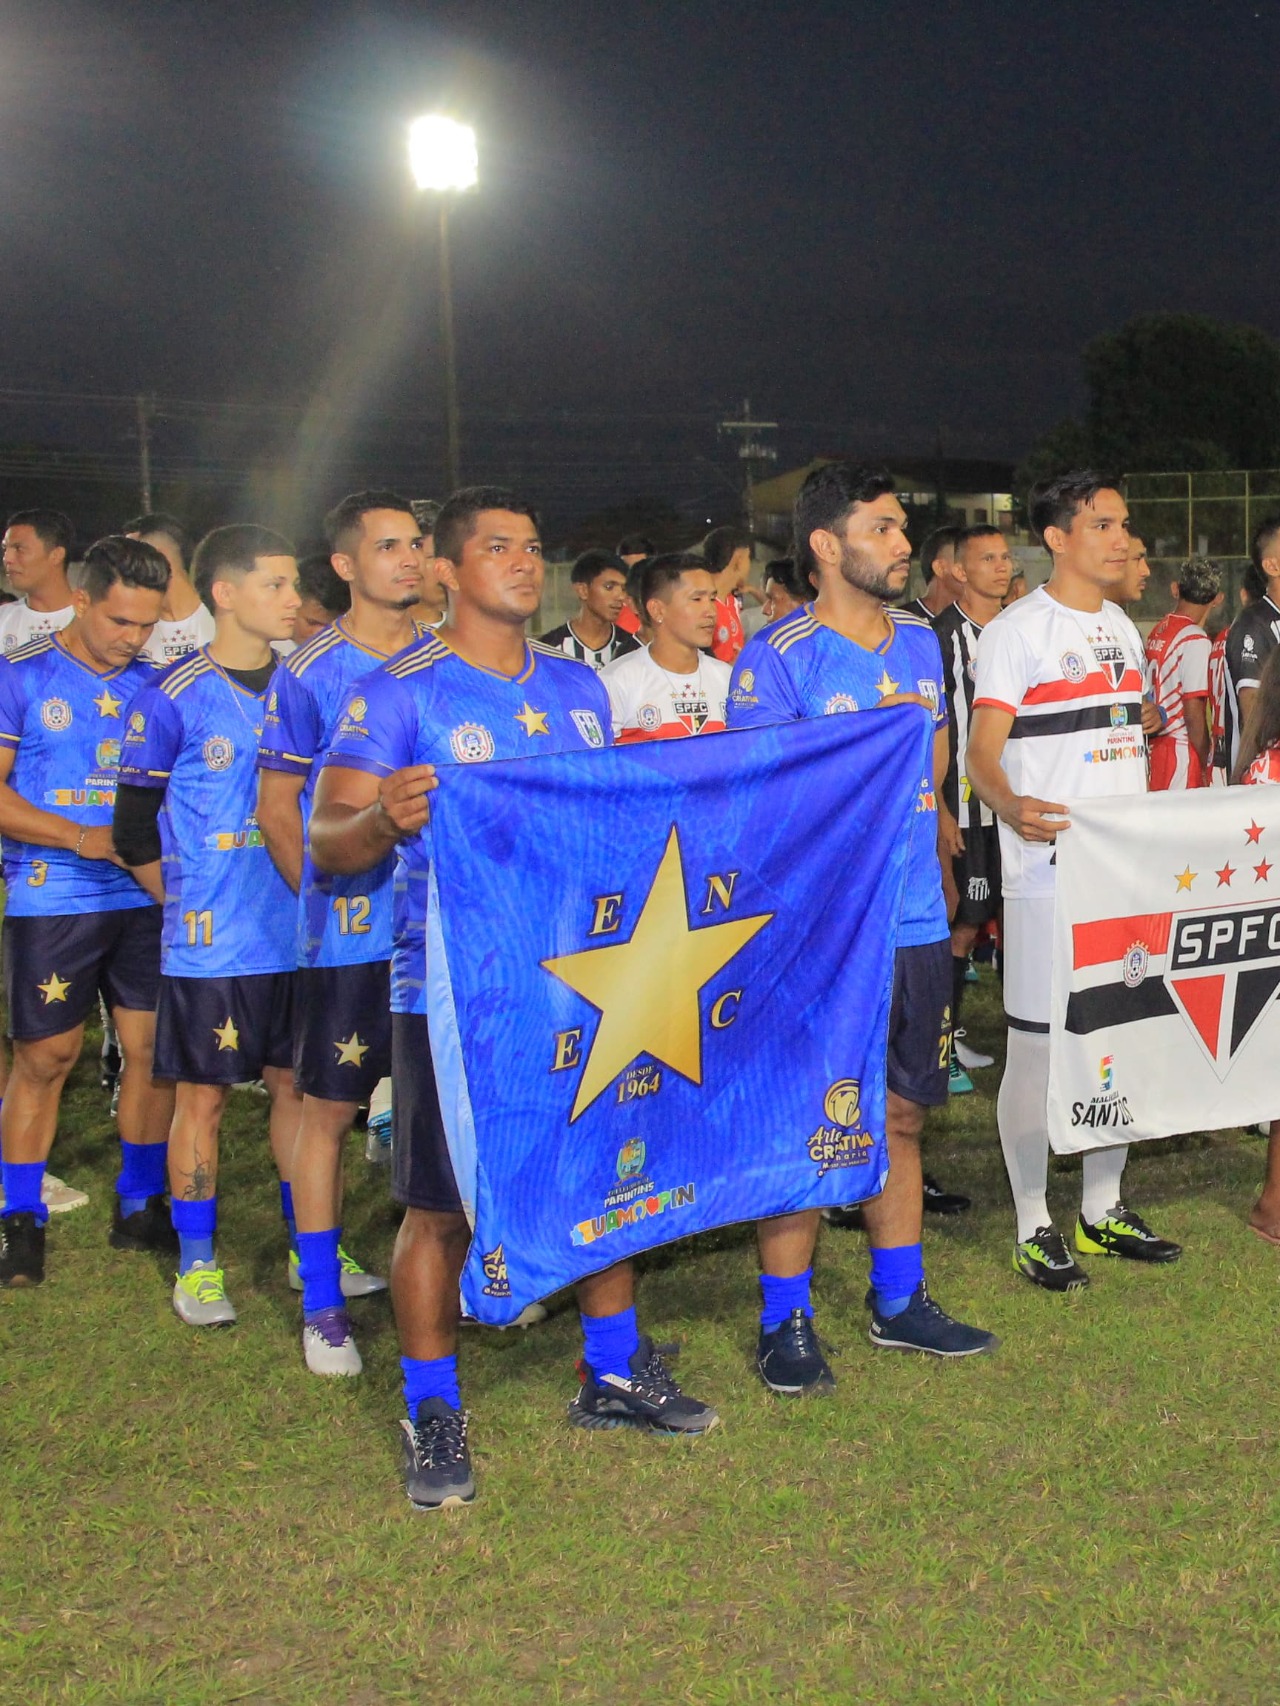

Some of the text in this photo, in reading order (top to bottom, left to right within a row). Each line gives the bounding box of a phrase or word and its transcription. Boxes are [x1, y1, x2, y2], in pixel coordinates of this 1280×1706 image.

[165, 644, 195, 656] SPFC
[1095, 648, 1124, 661] SPFC
[675, 703, 708, 713] SPFC
[27, 860, 48, 888] 3
[702, 872, 739, 914] N
[183, 910, 214, 946] 11
[333, 895, 371, 935] 12
[589, 894, 622, 936] E
[711, 989, 743, 1029] C
[551, 1029, 582, 1072] E
[617, 1072, 660, 1104] 1964
[626, 1065, 655, 1081] DESDE
[807, 1126, 843, 1146] Arte
[604, 1182, 655, 1208] PARINTINS
